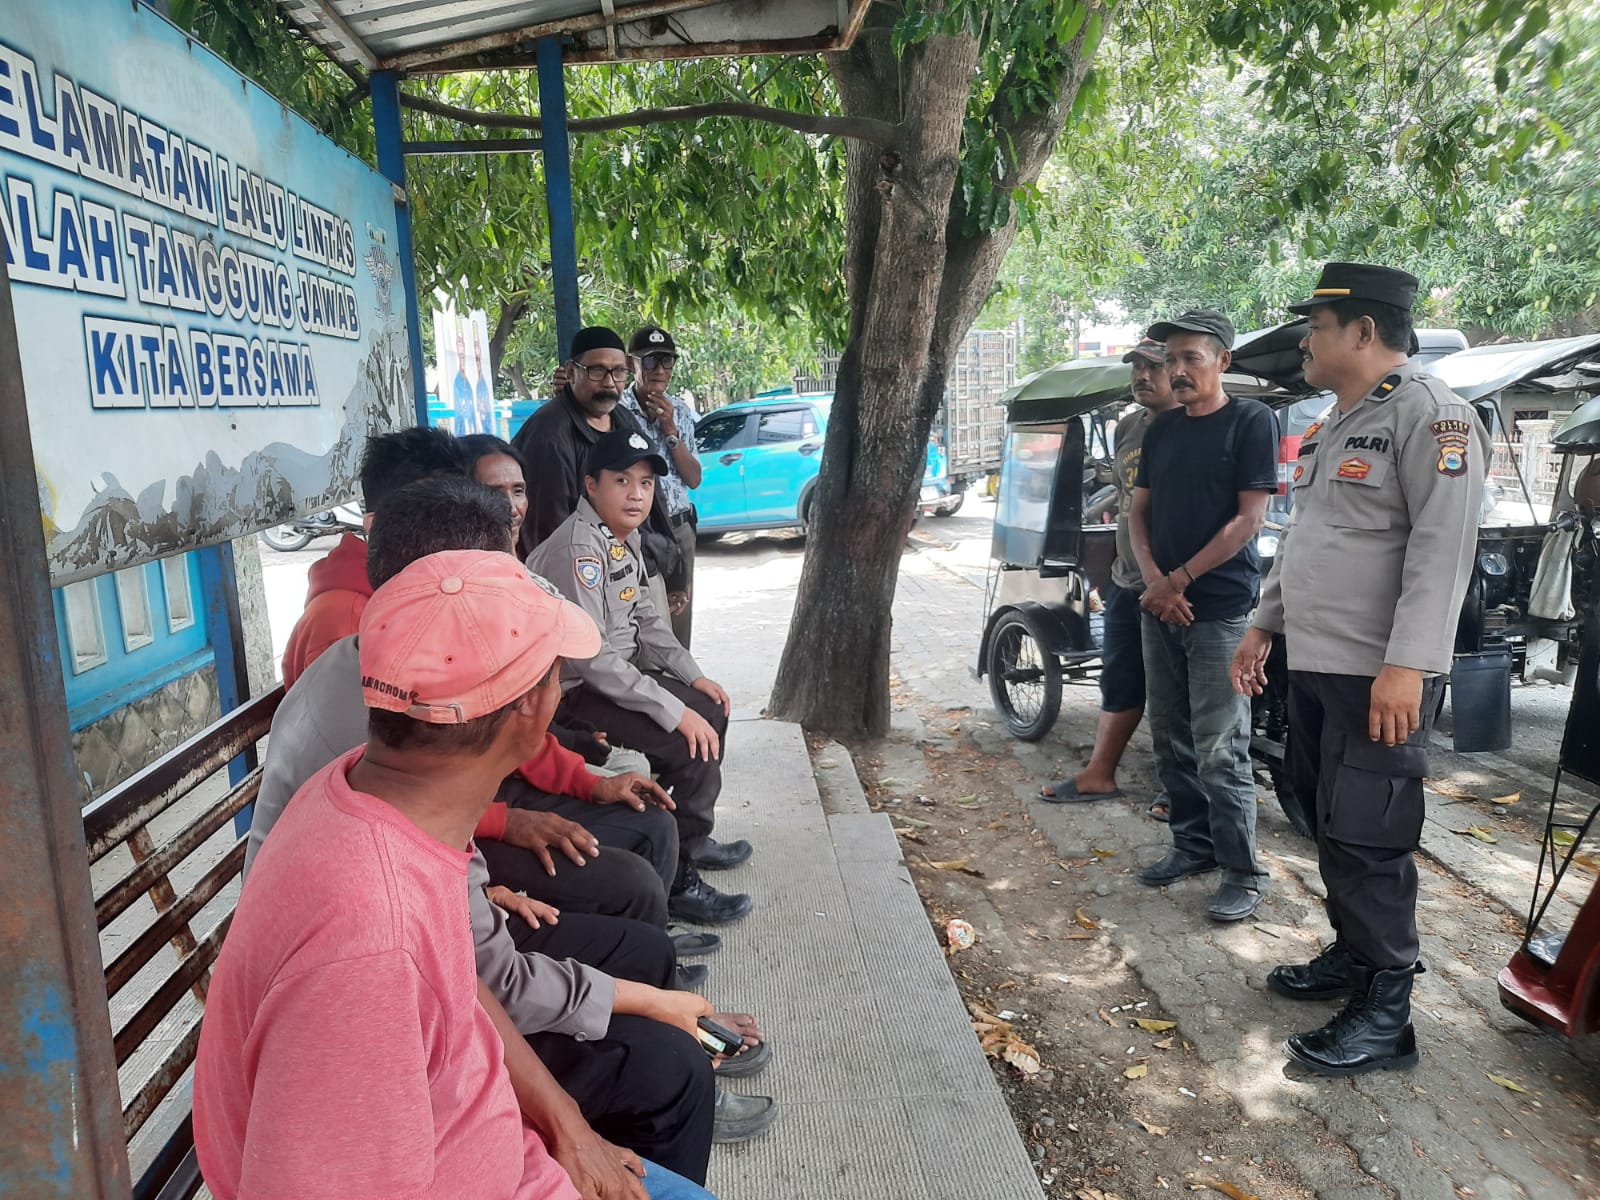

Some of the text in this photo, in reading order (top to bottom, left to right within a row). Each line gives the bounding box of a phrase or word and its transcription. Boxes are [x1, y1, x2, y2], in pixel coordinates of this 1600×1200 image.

[218, 162, 286, 245] LALU
[289, 197, 355, 275] LINTAS
[126, 221, 293, 324] TANGGUNG
[297, 276, 359, 336] JAWAB
[88, 323, 318, 402] KITA BERSAMA
[1344, 435, 1389, 453] POLRI
